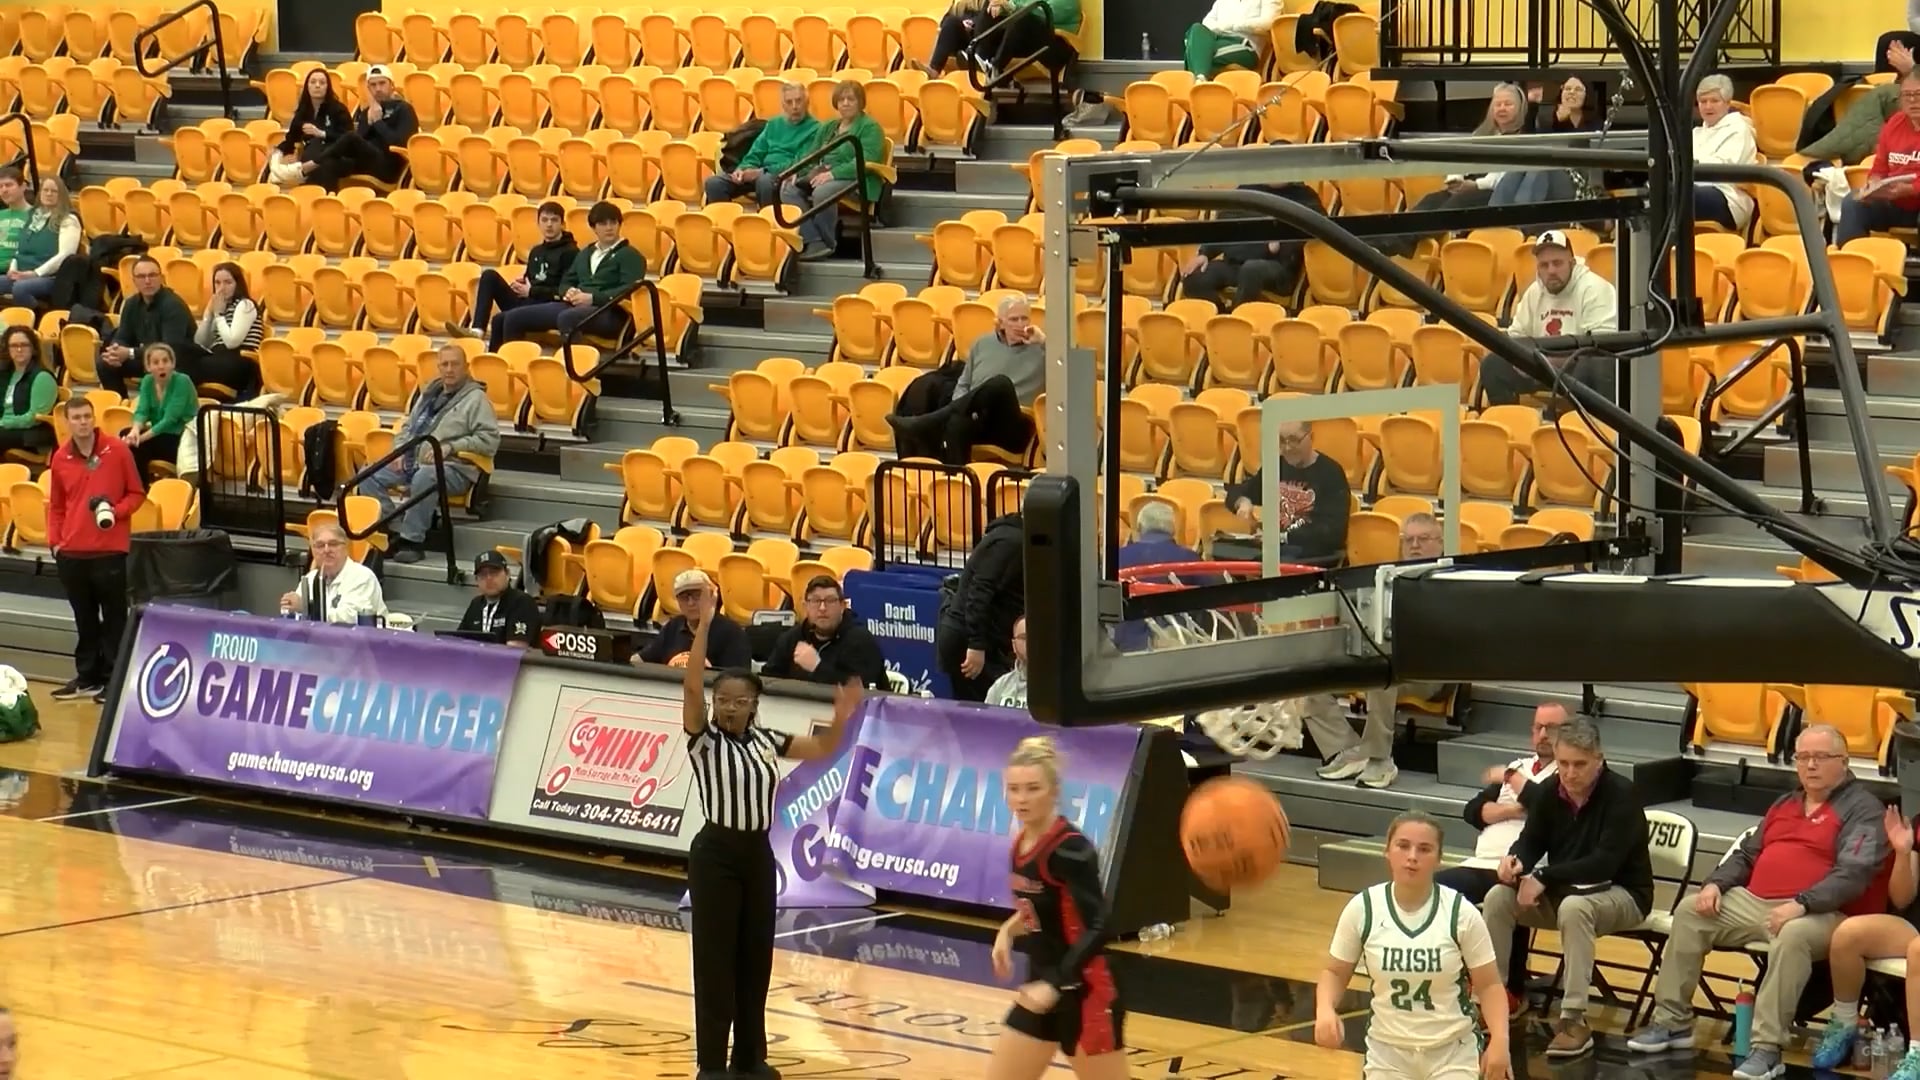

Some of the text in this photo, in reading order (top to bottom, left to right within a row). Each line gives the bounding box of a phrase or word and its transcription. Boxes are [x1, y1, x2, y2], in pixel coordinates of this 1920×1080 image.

[884, 602, 916, 621] Dardi
[556, 632, 597, 654] POSS
[867, 618, 935, 643] Distributing
[211, 633, 258, 663] PROUD
[583, 726, 669, 772] MINI'S
[227, 751, 374, 791] gamechangerusa.org
[787, 767, 843, 829] PROUD
[533, 799, 680, 832] Call Today! 304-755-6411
[1381, 947, 1442, 972] IRISH
[1390, 978, 1435, 1012] 24
